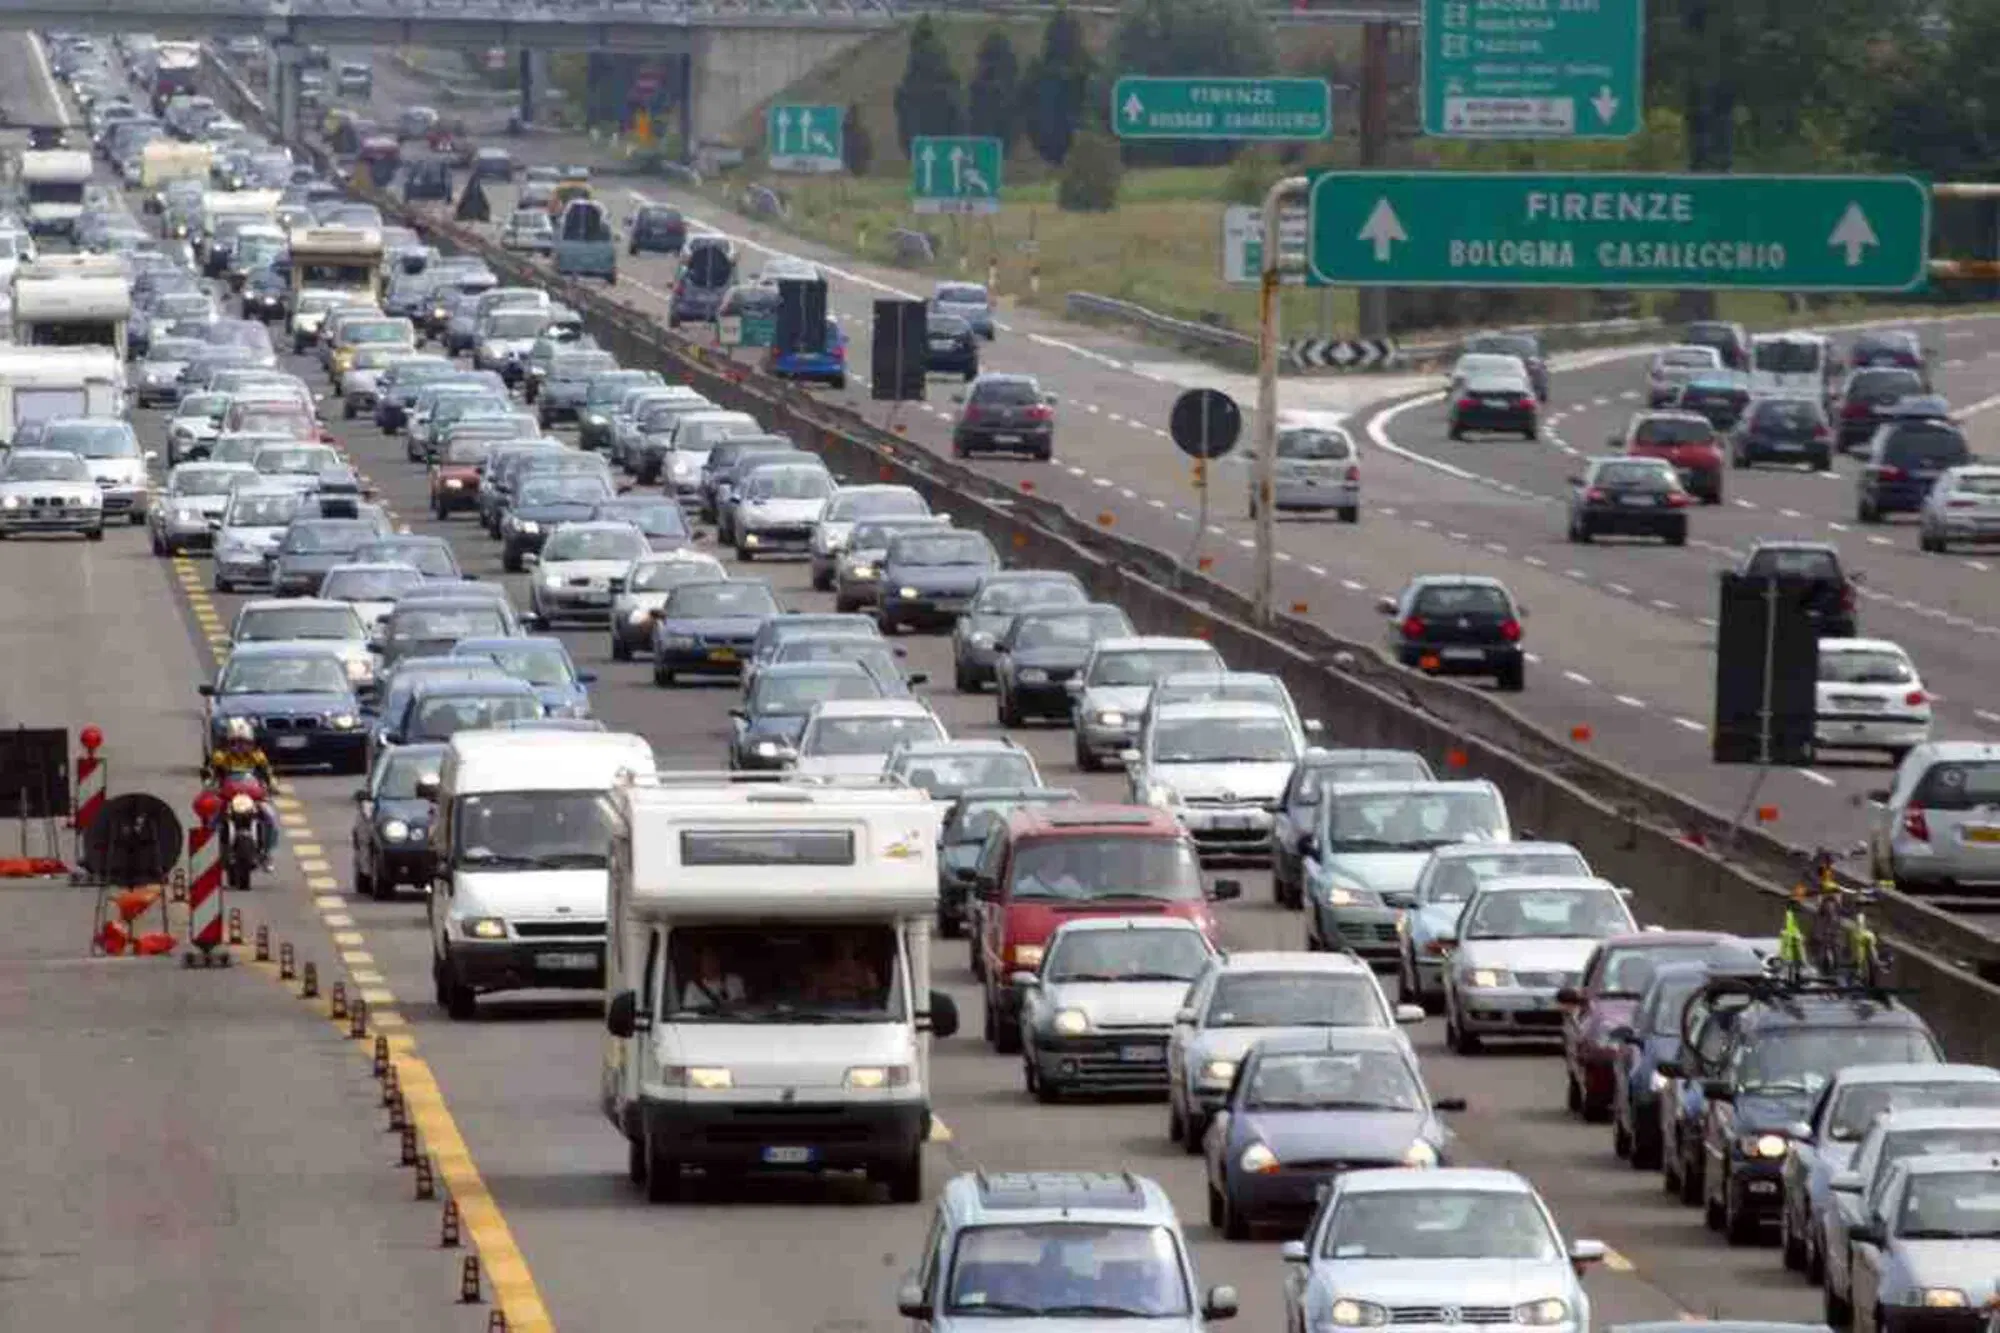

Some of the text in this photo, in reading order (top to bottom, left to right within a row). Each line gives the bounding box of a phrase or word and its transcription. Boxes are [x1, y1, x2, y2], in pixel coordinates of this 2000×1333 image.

[1527, 191, 1693, 222] FIRENZE
[1449, 239, 1786, 269] BOLOGNA CASALECCHIO
